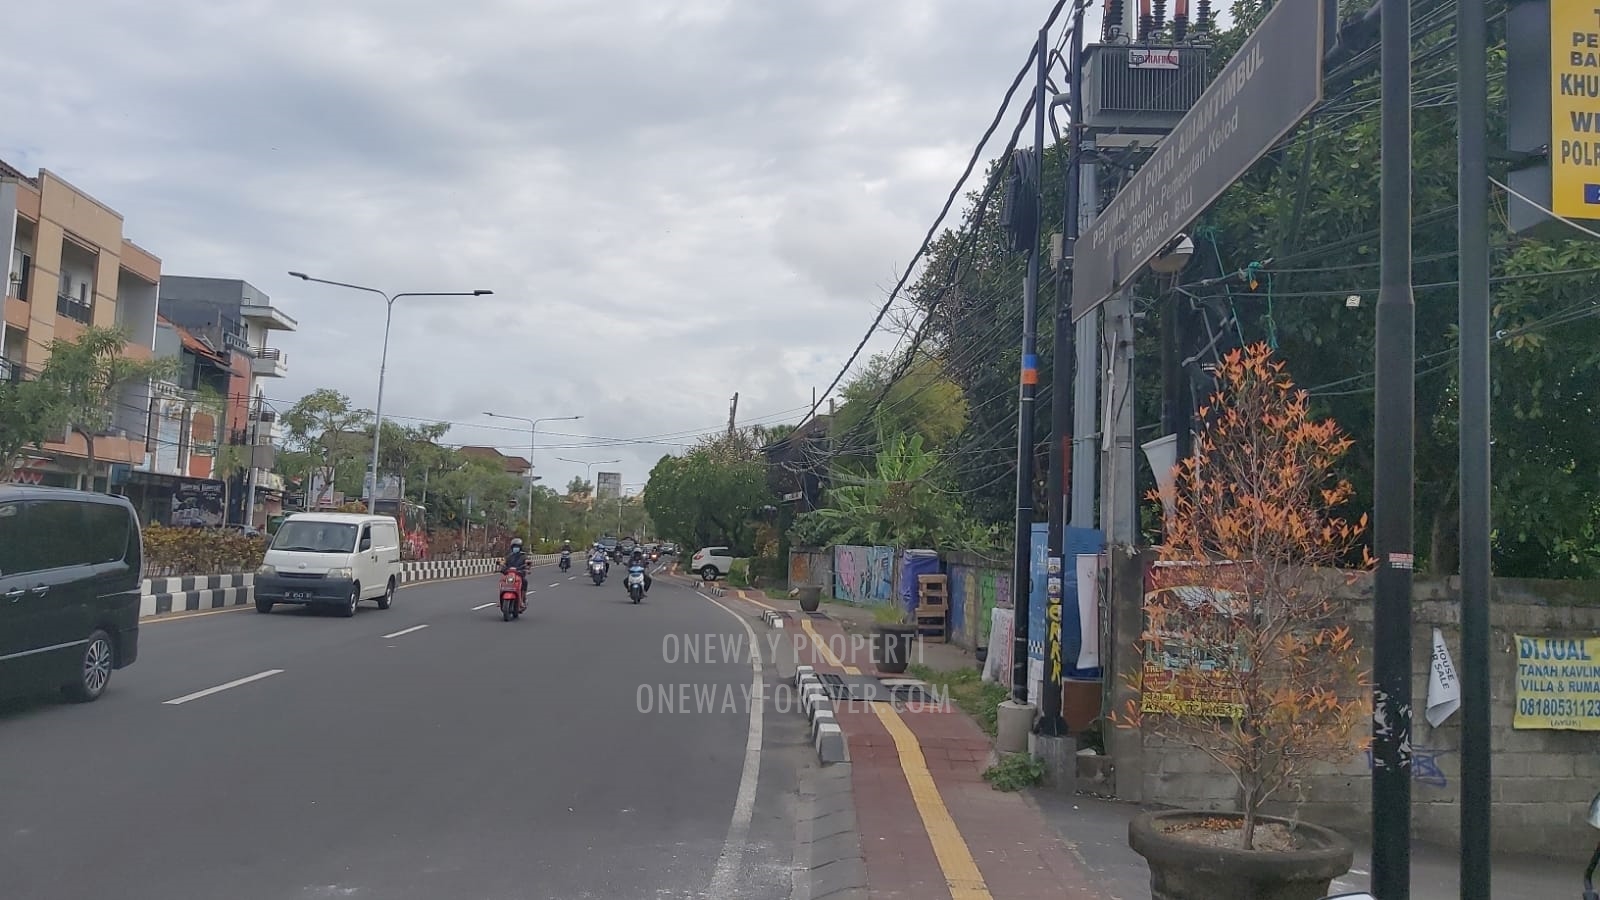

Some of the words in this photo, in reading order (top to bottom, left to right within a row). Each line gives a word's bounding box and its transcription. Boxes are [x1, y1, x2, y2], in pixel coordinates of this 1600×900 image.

[1571, 51, 1600, 68] BA
[1131, 193, 1155, 235] Bonjol
[1207, 105, 1239, 157] Kelod
[1144, 145, 1175, 195] POLRI
[1174, 184, 1193, 221] BALI
[1435, 644, 1455, 681] HOUSE
[1520, 639, 1592, 660] DIJUAL
[1434, 663, 1450, 690] SALE
[1519, 664, 1558, 677] TANAH
[1521, 679, 1554, 692] VILLA
[1556, 680, 1565, 692] &
